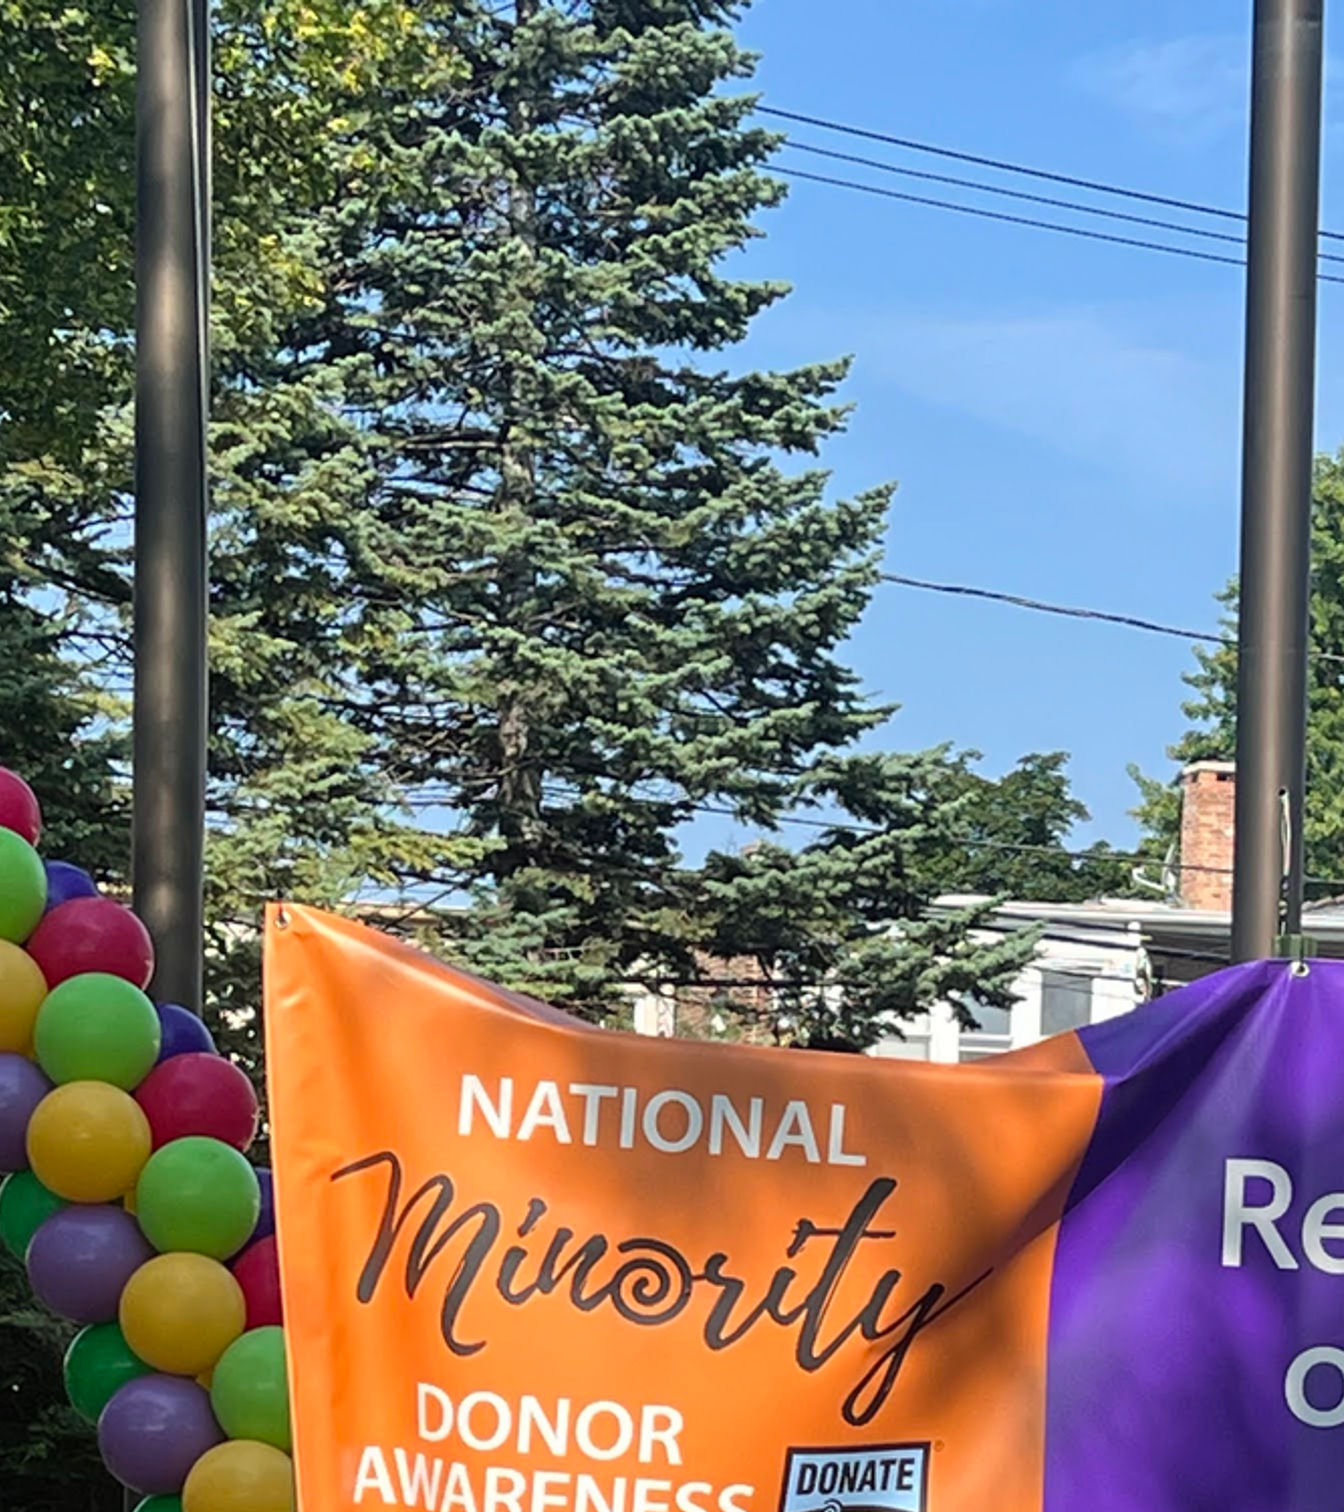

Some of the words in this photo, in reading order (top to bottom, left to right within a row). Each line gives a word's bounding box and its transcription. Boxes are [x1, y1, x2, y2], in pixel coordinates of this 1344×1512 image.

[457, 1074, 867, 1167] NATIONAL
[331, 1150, 993, 1427] Minority
[417, 1382, 684, 1466] DONOR
[795, 1457, 916, 1496] DONATE
